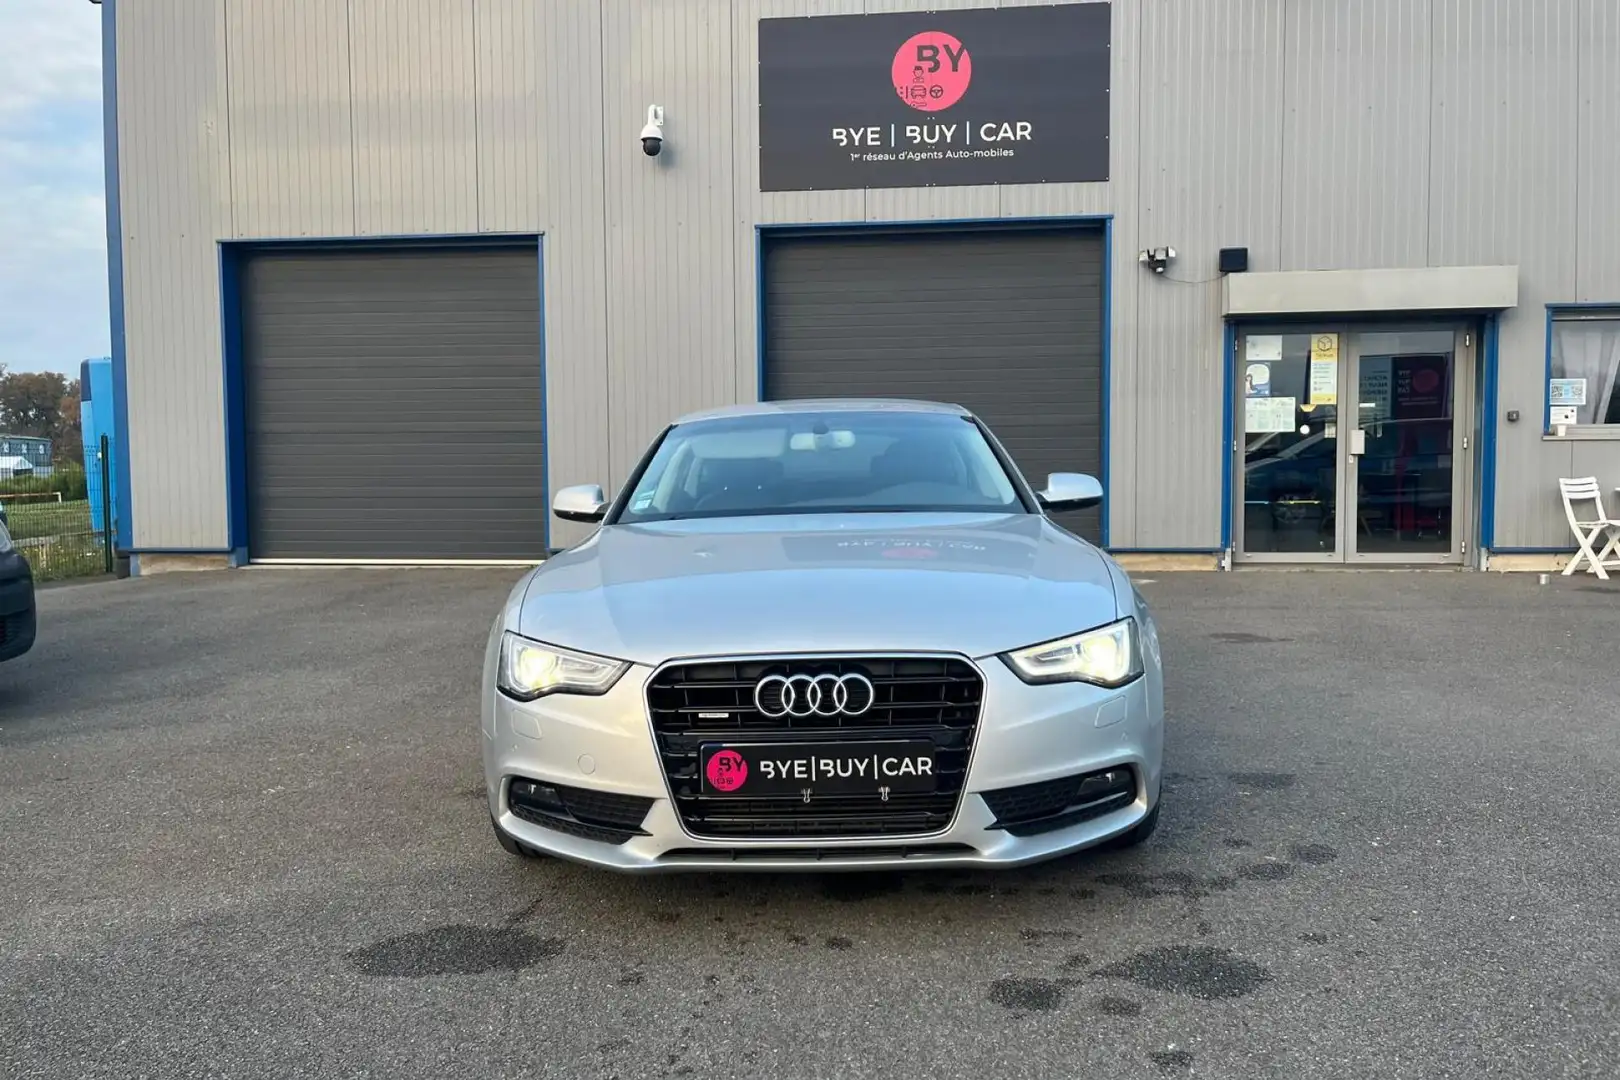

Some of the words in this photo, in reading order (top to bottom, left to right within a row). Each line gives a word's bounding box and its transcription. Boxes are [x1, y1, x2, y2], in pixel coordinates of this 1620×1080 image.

[917, 44, 965, 73] BY
[832, 126, 881, 147] BYE
[905, 123, 957, 144] BUY
[979, 121, 1032, 142] CAR
[862, 151, 895, 161] réseau
[898, 149, 943, 161] d'Agents
[945, 147, 1014, 159] Auto-mobiles
[882, 756, 932, 776] CAR
